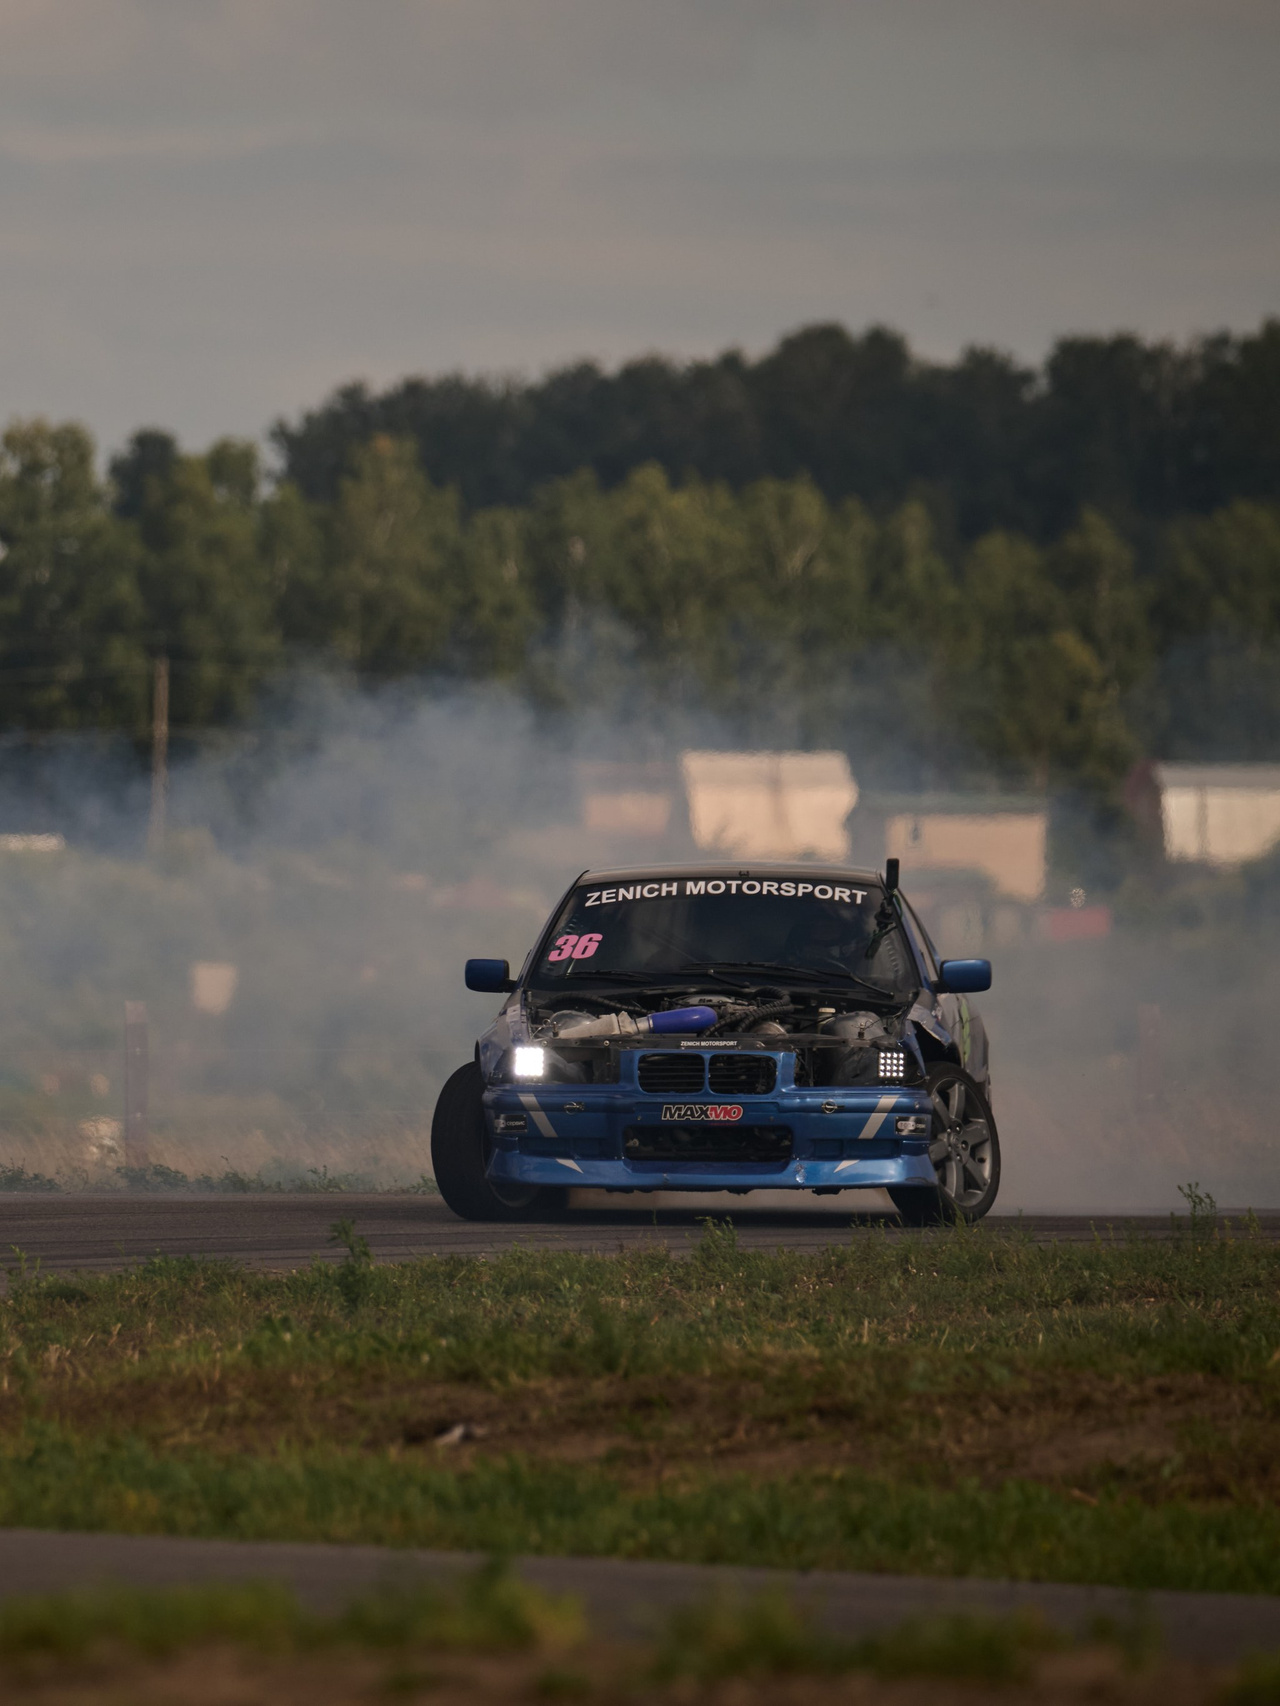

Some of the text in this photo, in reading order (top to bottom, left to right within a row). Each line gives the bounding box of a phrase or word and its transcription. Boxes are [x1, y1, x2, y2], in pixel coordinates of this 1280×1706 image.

[584, 880, 867, 907] ZENICH MOTORSPORT
[548, 933, 603, 962] 36
[661, 1105, 743, 1121] MAXMO
